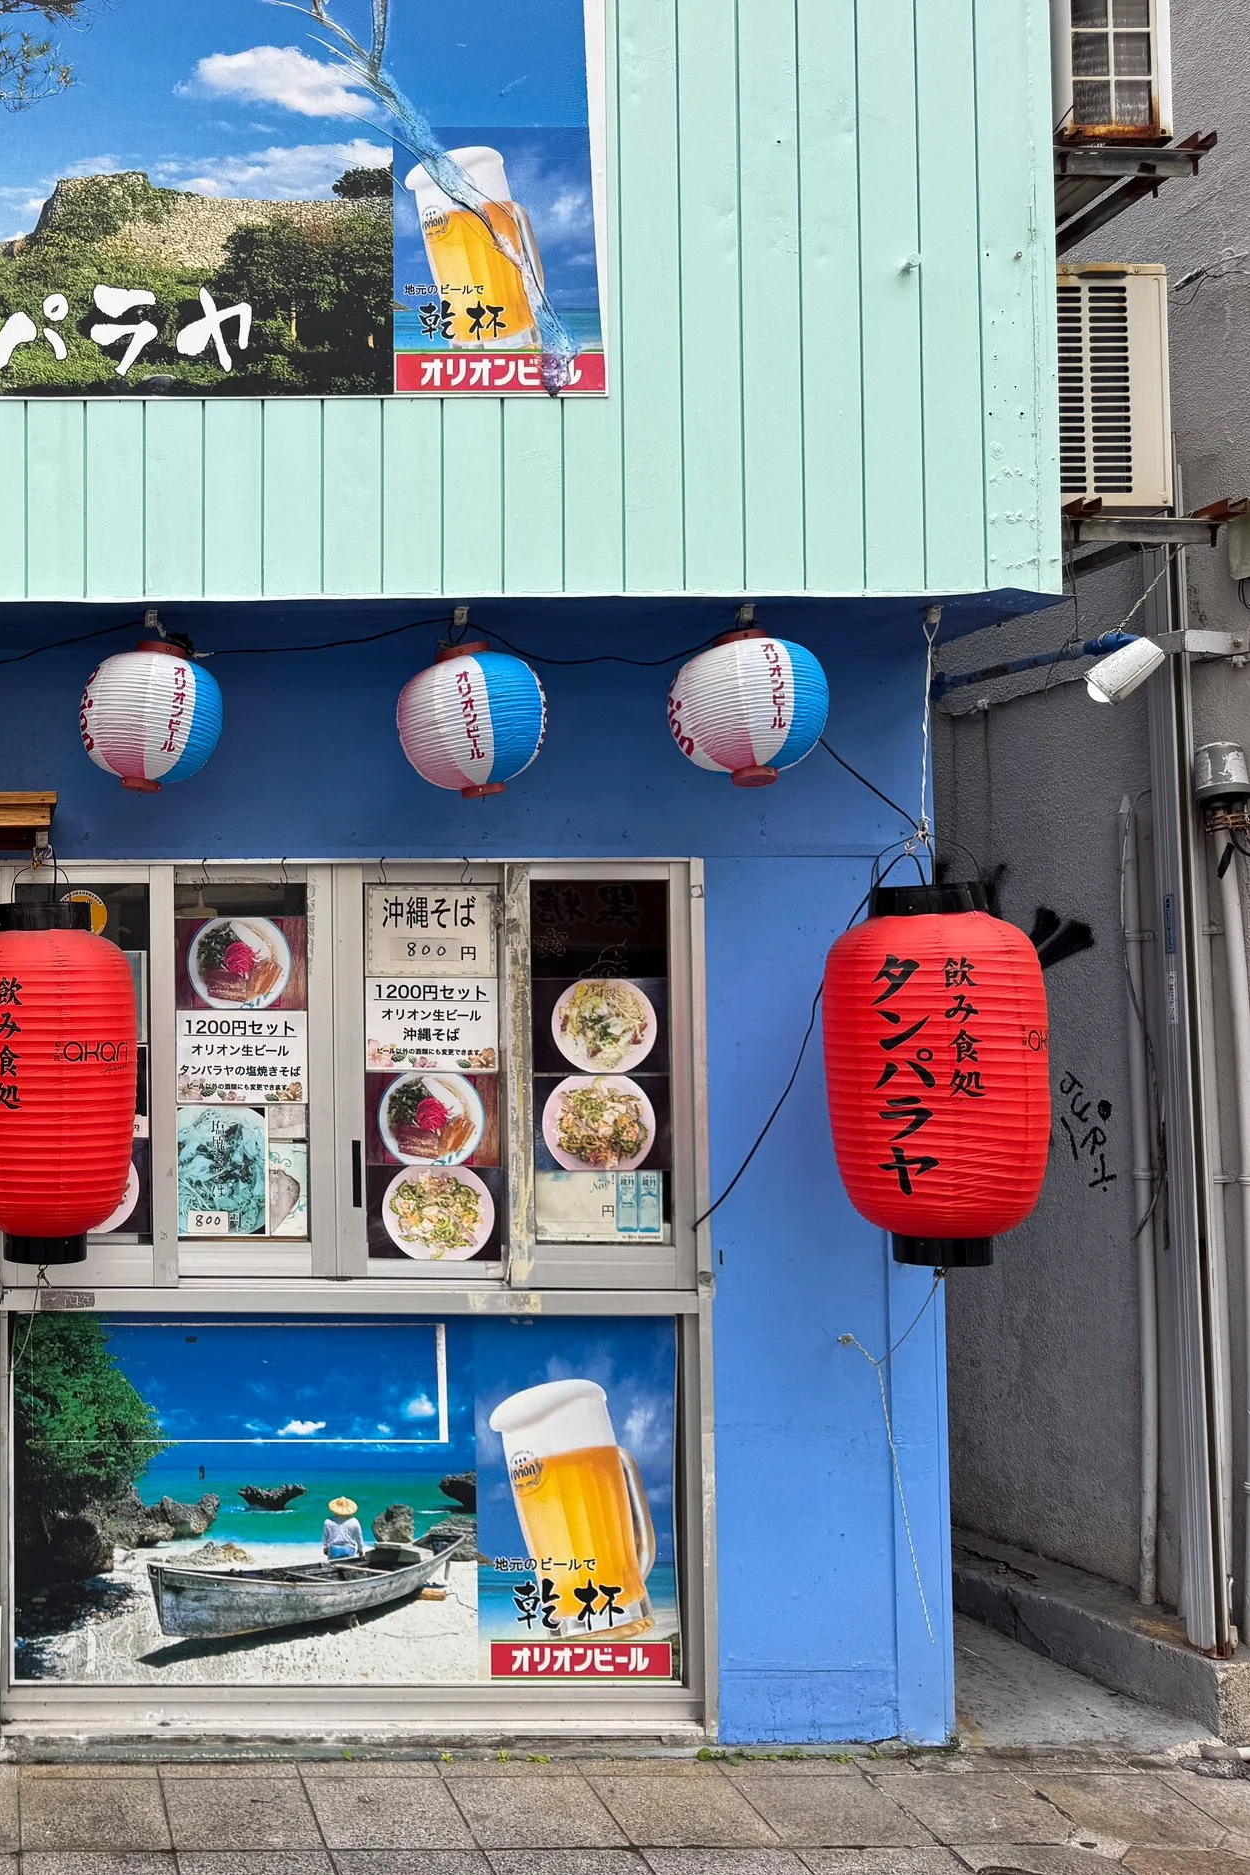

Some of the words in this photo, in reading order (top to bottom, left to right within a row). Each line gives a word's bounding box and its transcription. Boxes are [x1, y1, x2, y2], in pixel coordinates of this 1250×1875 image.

[404, 284, 484, 295] 地元のビールで
[419, 300, 507, 341] 乾杯
[421, 359, 582, 387] オリオンビ
[761, 643, 787, 729] オリオンビール
[160, 666, 187, 753] オリオンビール
[456, 670, 485, 761] オリオンビール
[382, 896, 476, 929] 沖縄そば
[407, 942, 446, 957] 800
[461, 946, 476, 961] 円
[375, 984, 487, 1001] 1200円セット
[381, 1009, 481, 1022] オリオン生ビール
[185, 1019, 295, 1036] 1200円セット
[403, 1028, 460, 1042] 沖縄そば
[942, 956, 987, 1097] 飲み食処
[63, 1041, 128, 1061] akari
[191, 1044, 290, 1057] オリオン生ビール
[870, 954, 940, 1196] タンパラヤ
[195, 1214, 221, 1227] 800
[602, 1205, 615, 1217] 円
[495, 1557, 596, 1572] 地元のビールで
[513, 1577, 625, 1631] 乾杯
[512, 1647, 650, 1673] オリオンビール
